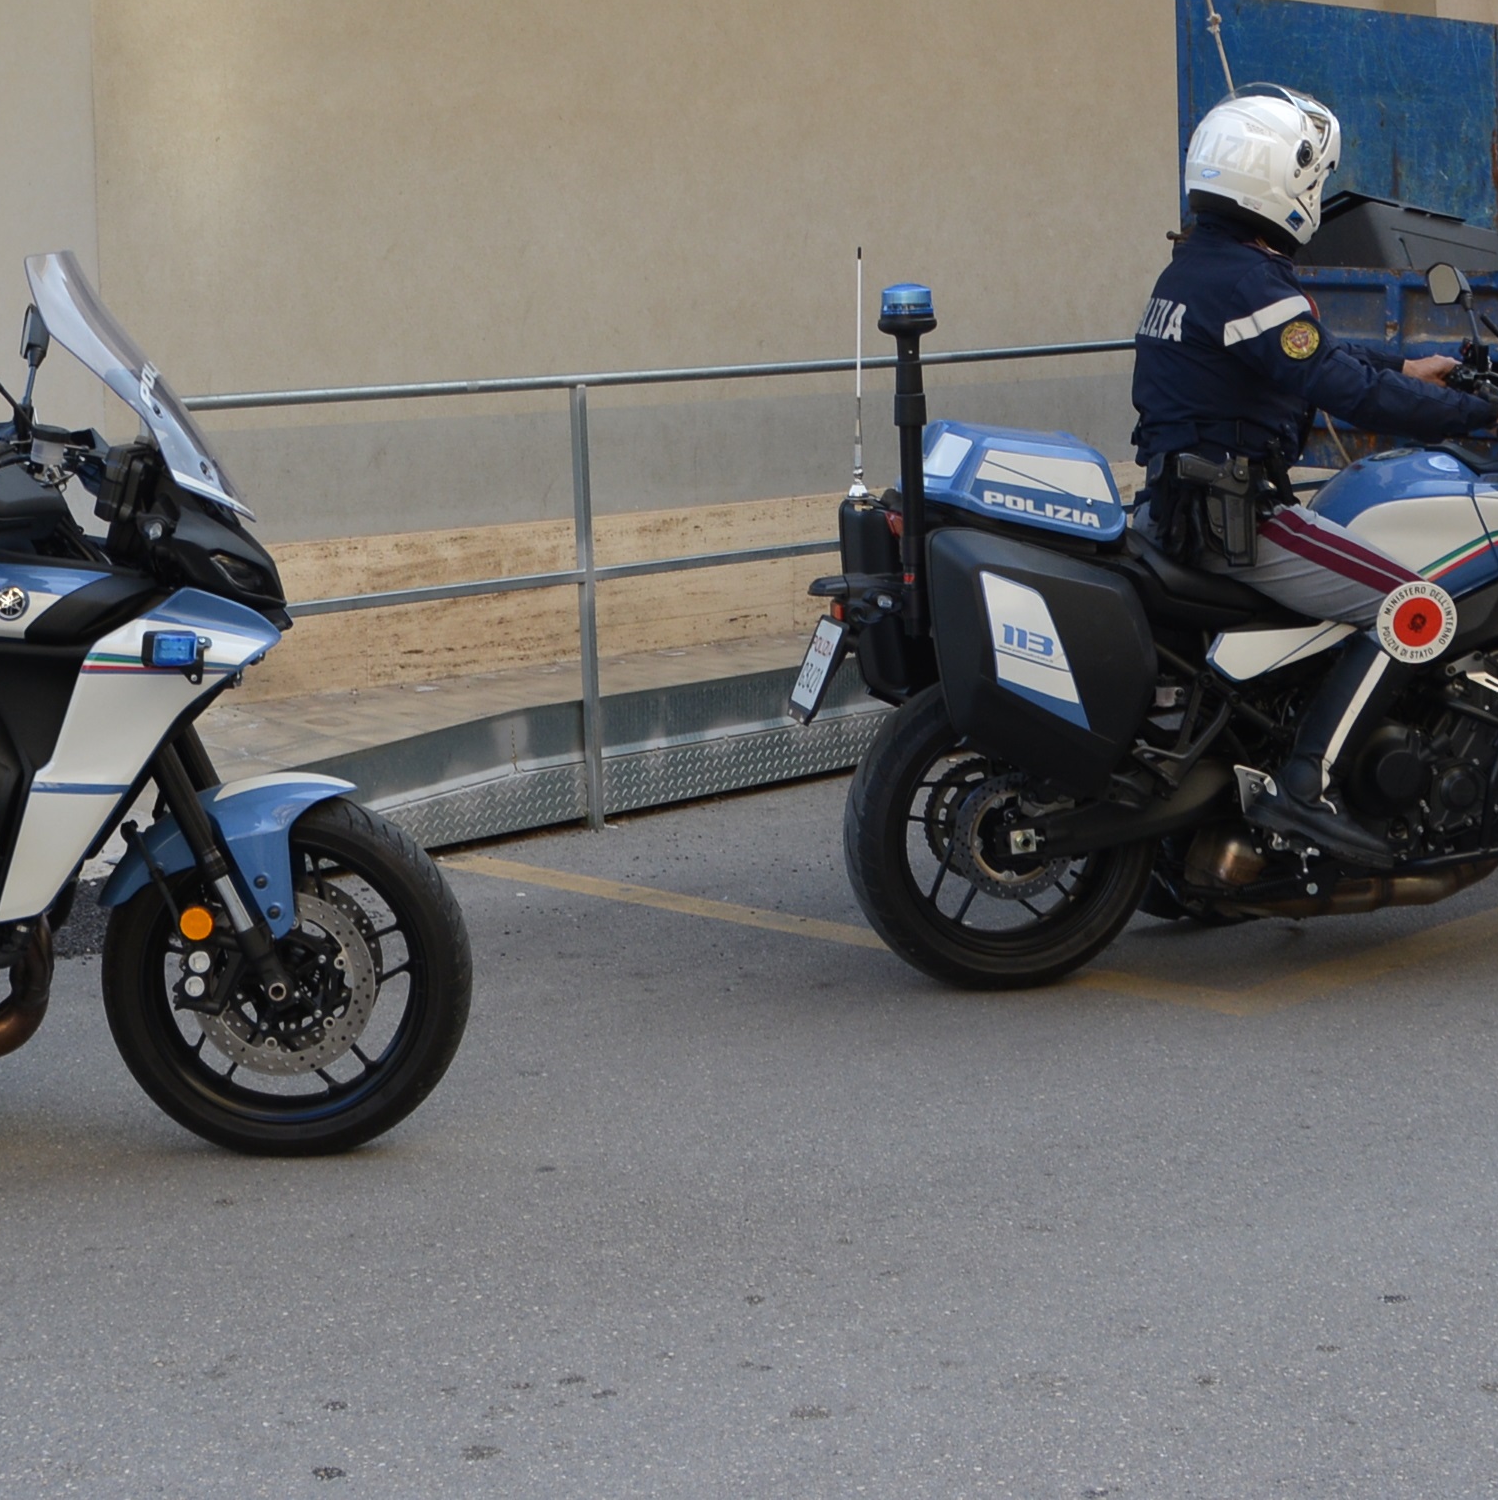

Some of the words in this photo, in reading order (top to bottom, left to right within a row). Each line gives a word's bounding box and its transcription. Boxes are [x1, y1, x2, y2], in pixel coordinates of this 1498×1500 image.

[1138, 298, 1186, 342] LIZIA
[983, 490, 1100, 528] POLIZIA
[1384, 586, 1426, 616] MINISTERO
[1429, 589, 1454, 645] DELL'INTERNO
[1002, 623, 1054, 657] 113
[1382, 626, 1400, 652] POLIZIA
[1400, 648, 1408, 658] DI
[1410, 647, 1433, 659] STATO
